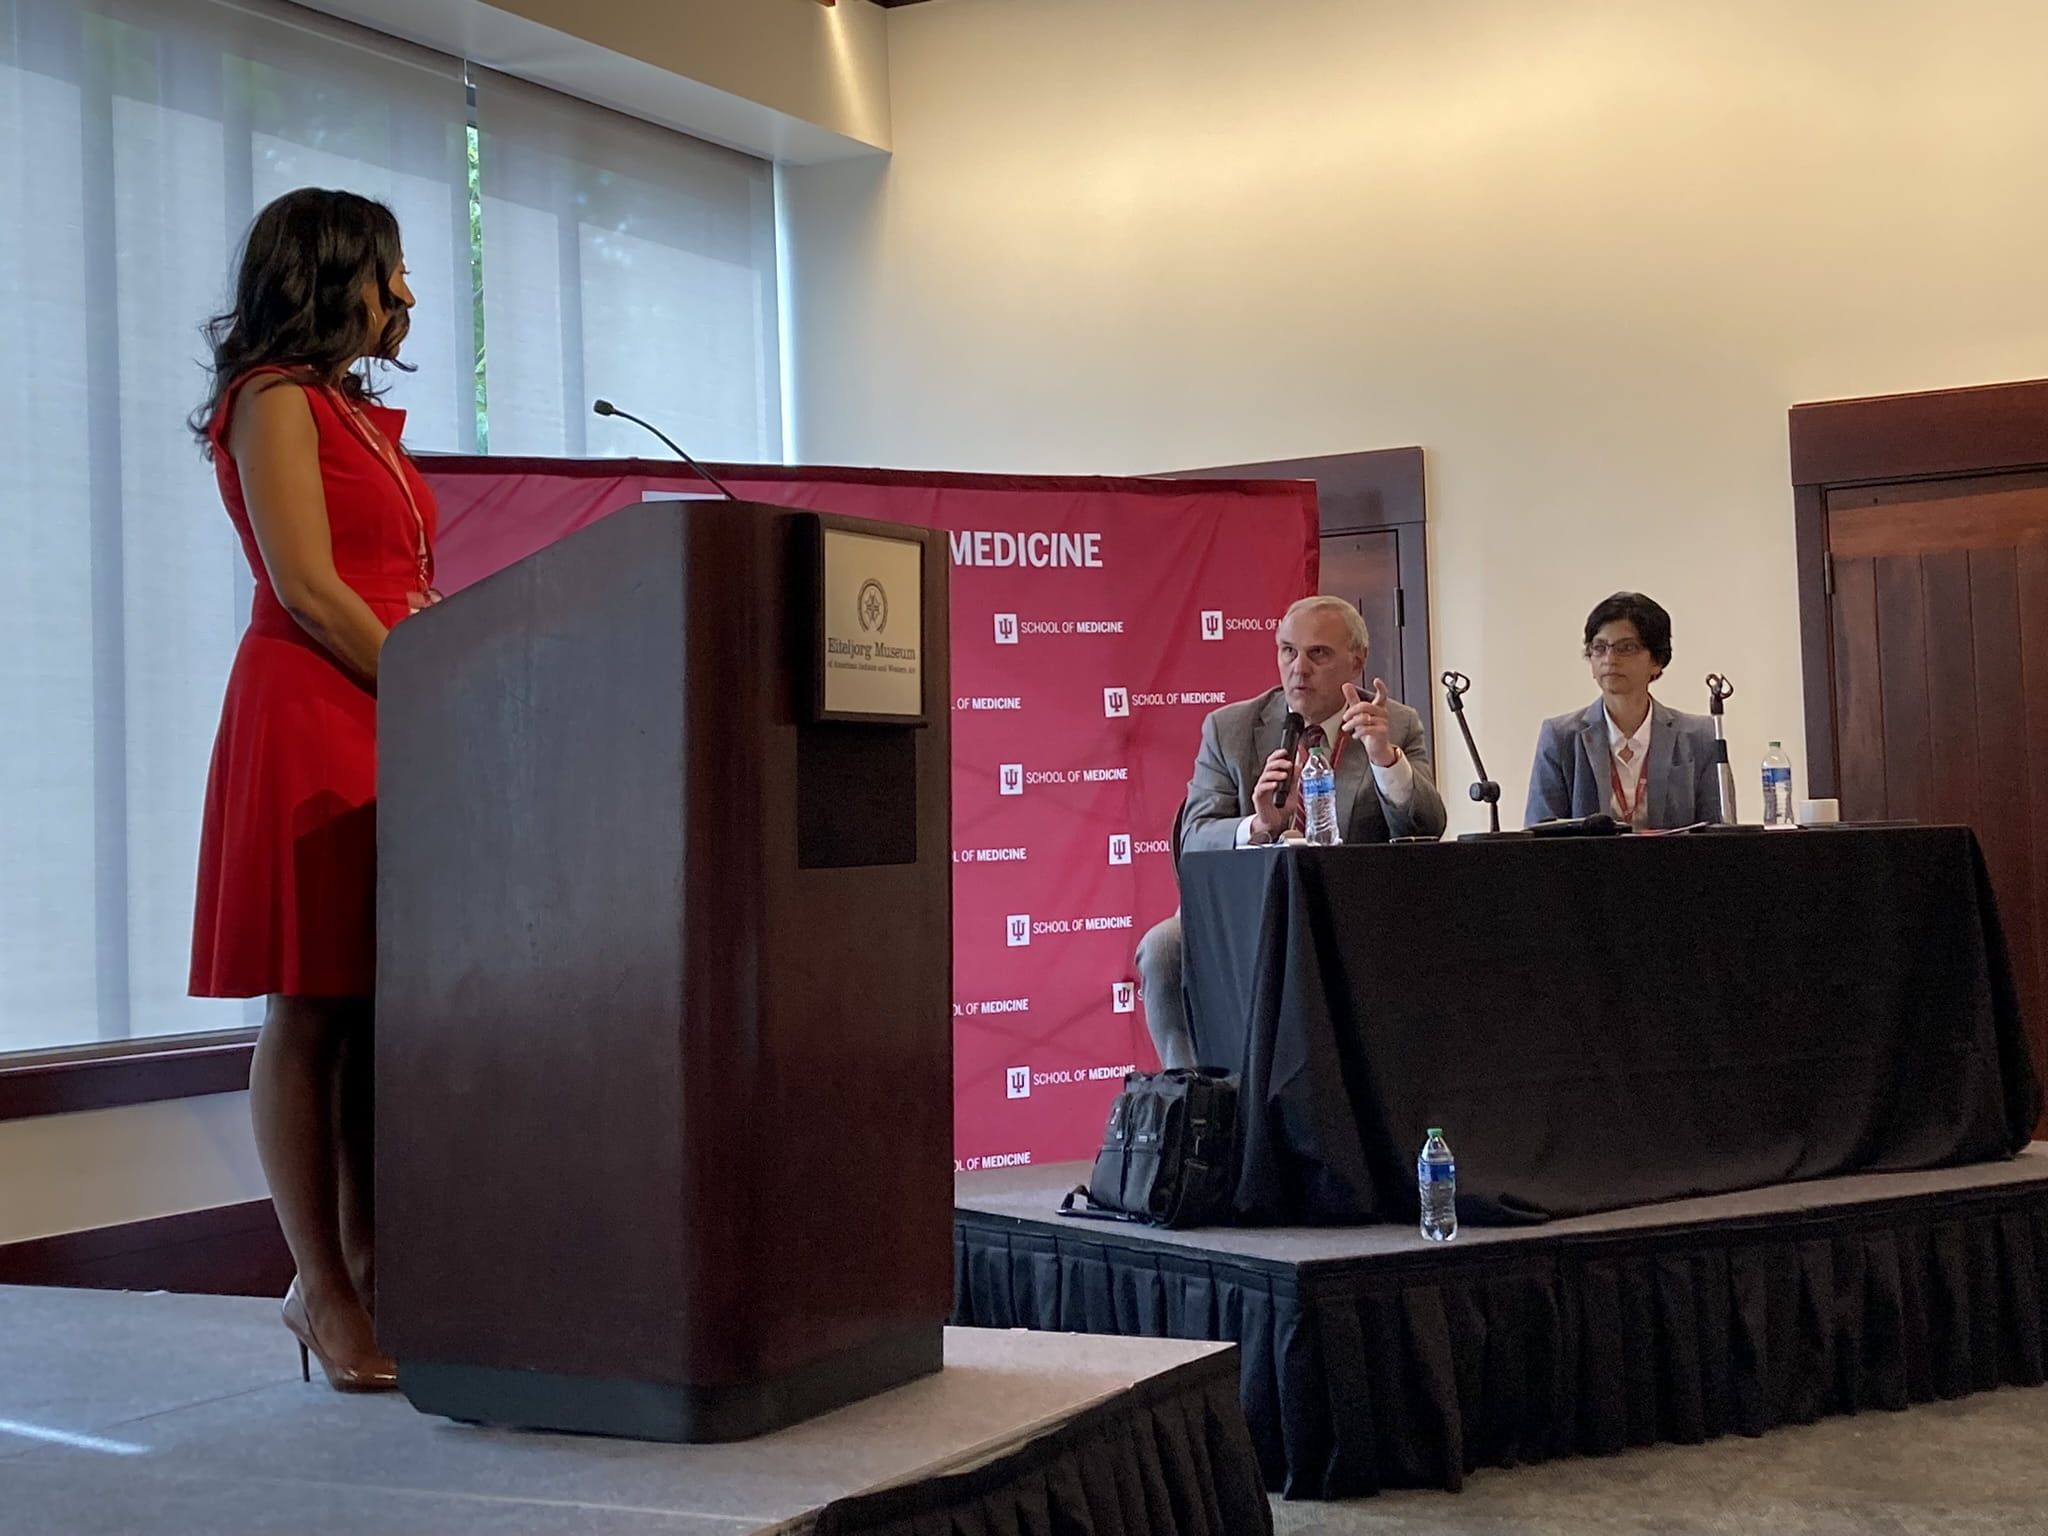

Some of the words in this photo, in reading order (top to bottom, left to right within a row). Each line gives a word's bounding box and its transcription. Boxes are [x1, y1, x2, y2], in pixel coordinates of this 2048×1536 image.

[950, 530, 1103, 567] MEDICINE
[1021, 621, 1060, 634] SCHOOL
[1062, 621, 1075, 633] OF
[1076, 621, 1124, 633] MEDICINE
[1225, 618, 1263, 631] SCHOOL
[1265, 618, 1278, 631] OF
[874, 642, 916, 660] Museum
[957, 697, 970, 710] OF
[972, 697, 1021, 710] MEDICINE
[1132, 694, 1165, 707] SCHOOL
[1166, 693, 1179, 705] OF
[1181, 692, 1226, 704] MEDICINE
[1026, 771, 1065, 784] SCHOOL
[1067, 770, 1081, 782] OF
[1083, 768, 1128, 781] MEDICINE
[961, 849, 975, 862] OF
[976, 847, 1027, 862] MEDICINE
[1133, 840, 1170, 854] SCHOOL
[1033, 920, 1071, 934] SCHOOL
[1072, 919, 1084, 931] OF
[1085, 916, 1133, 930] MEDICINE
[965, 1002, 979, 1015] OF
[981, 998, 1029, 1014] MEDICINE
[1033, 1072, 1072, 1086] SCHOOL
[1074, 1070, 1087, 1081] OF
[966, 1157, 980, 1171] OF
[982, 1151, 1031, 1169] MEDICINE
